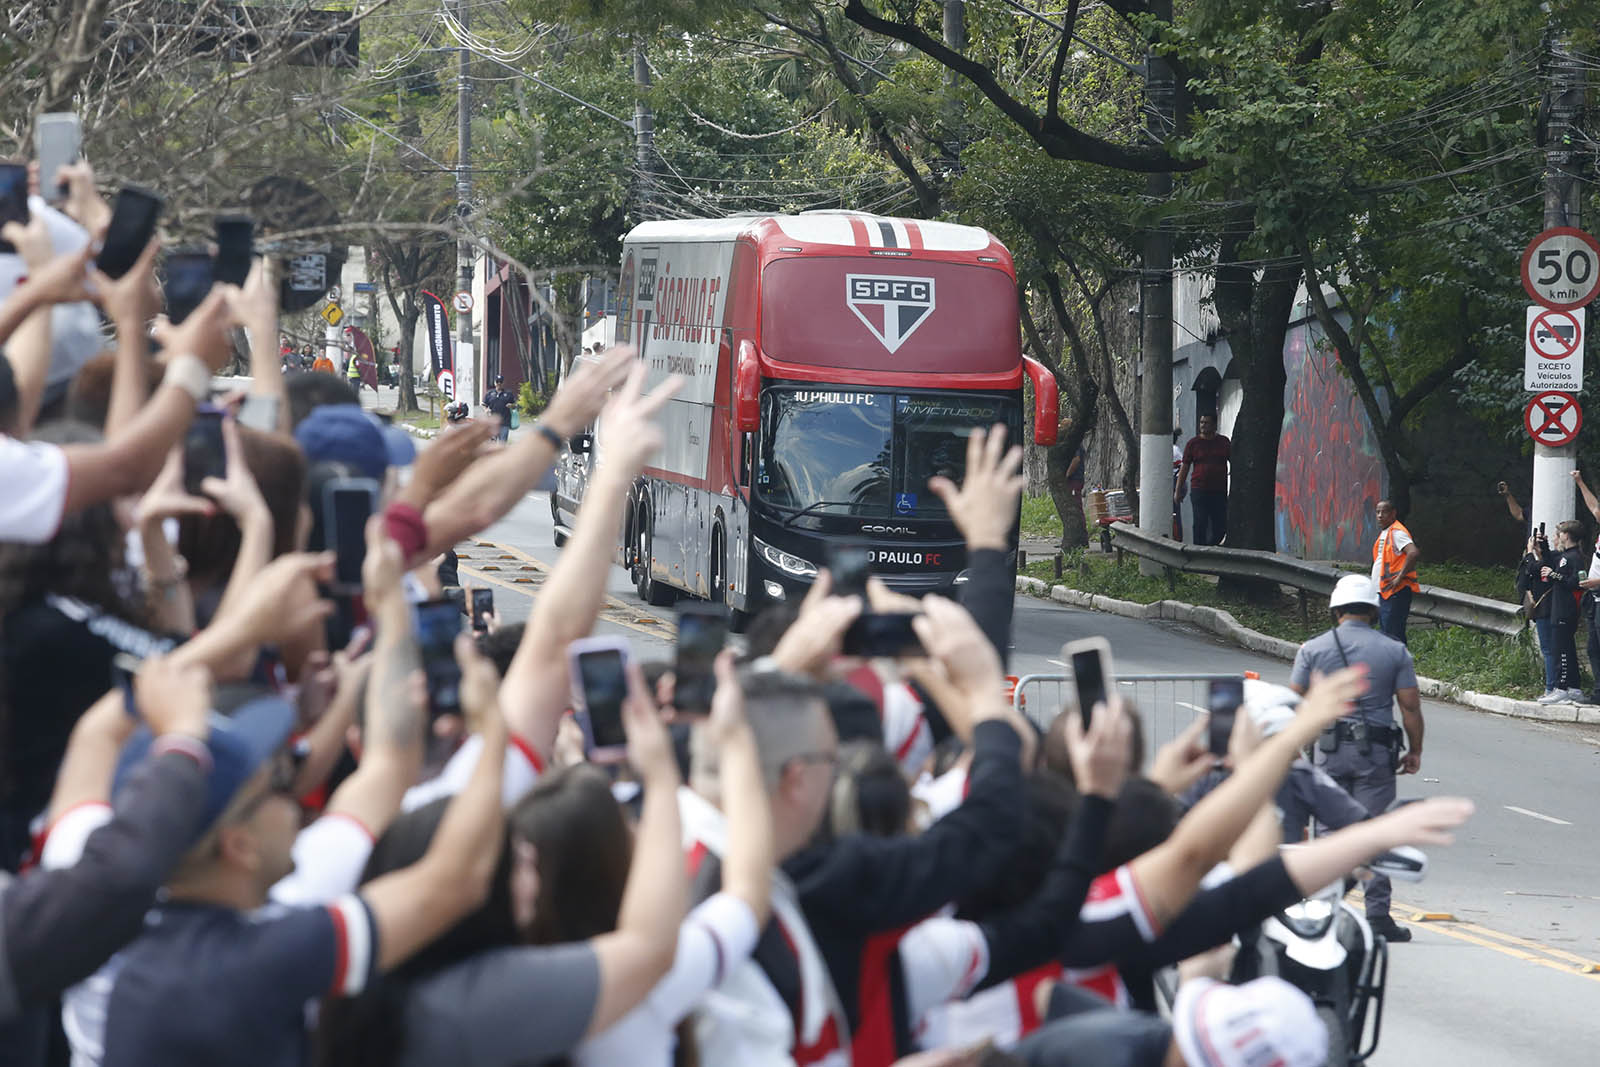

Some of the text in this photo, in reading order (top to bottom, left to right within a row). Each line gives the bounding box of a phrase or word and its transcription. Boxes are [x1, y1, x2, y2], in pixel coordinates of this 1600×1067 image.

[1537, 249, 1591, 286] 50
[855, 281, 926, 300] SPFC
[1549, 289, 1579, 299] km/h
[672, 276, 707, 344] PAULO
[704, 275, 721, 345] FC
[1537, 362, 1571, 370] EXCETO
[444, 378, 452, 395] E
[1530, 381, 1578, 390] Autorizados
[810, 391, 854, 405] PAULO
[856, 393, 874, 406] FC
[861, 525, 917, 535] COMIL
[879, 551, 922, 564] PAULO
[925, 553, 942, 565] FC
